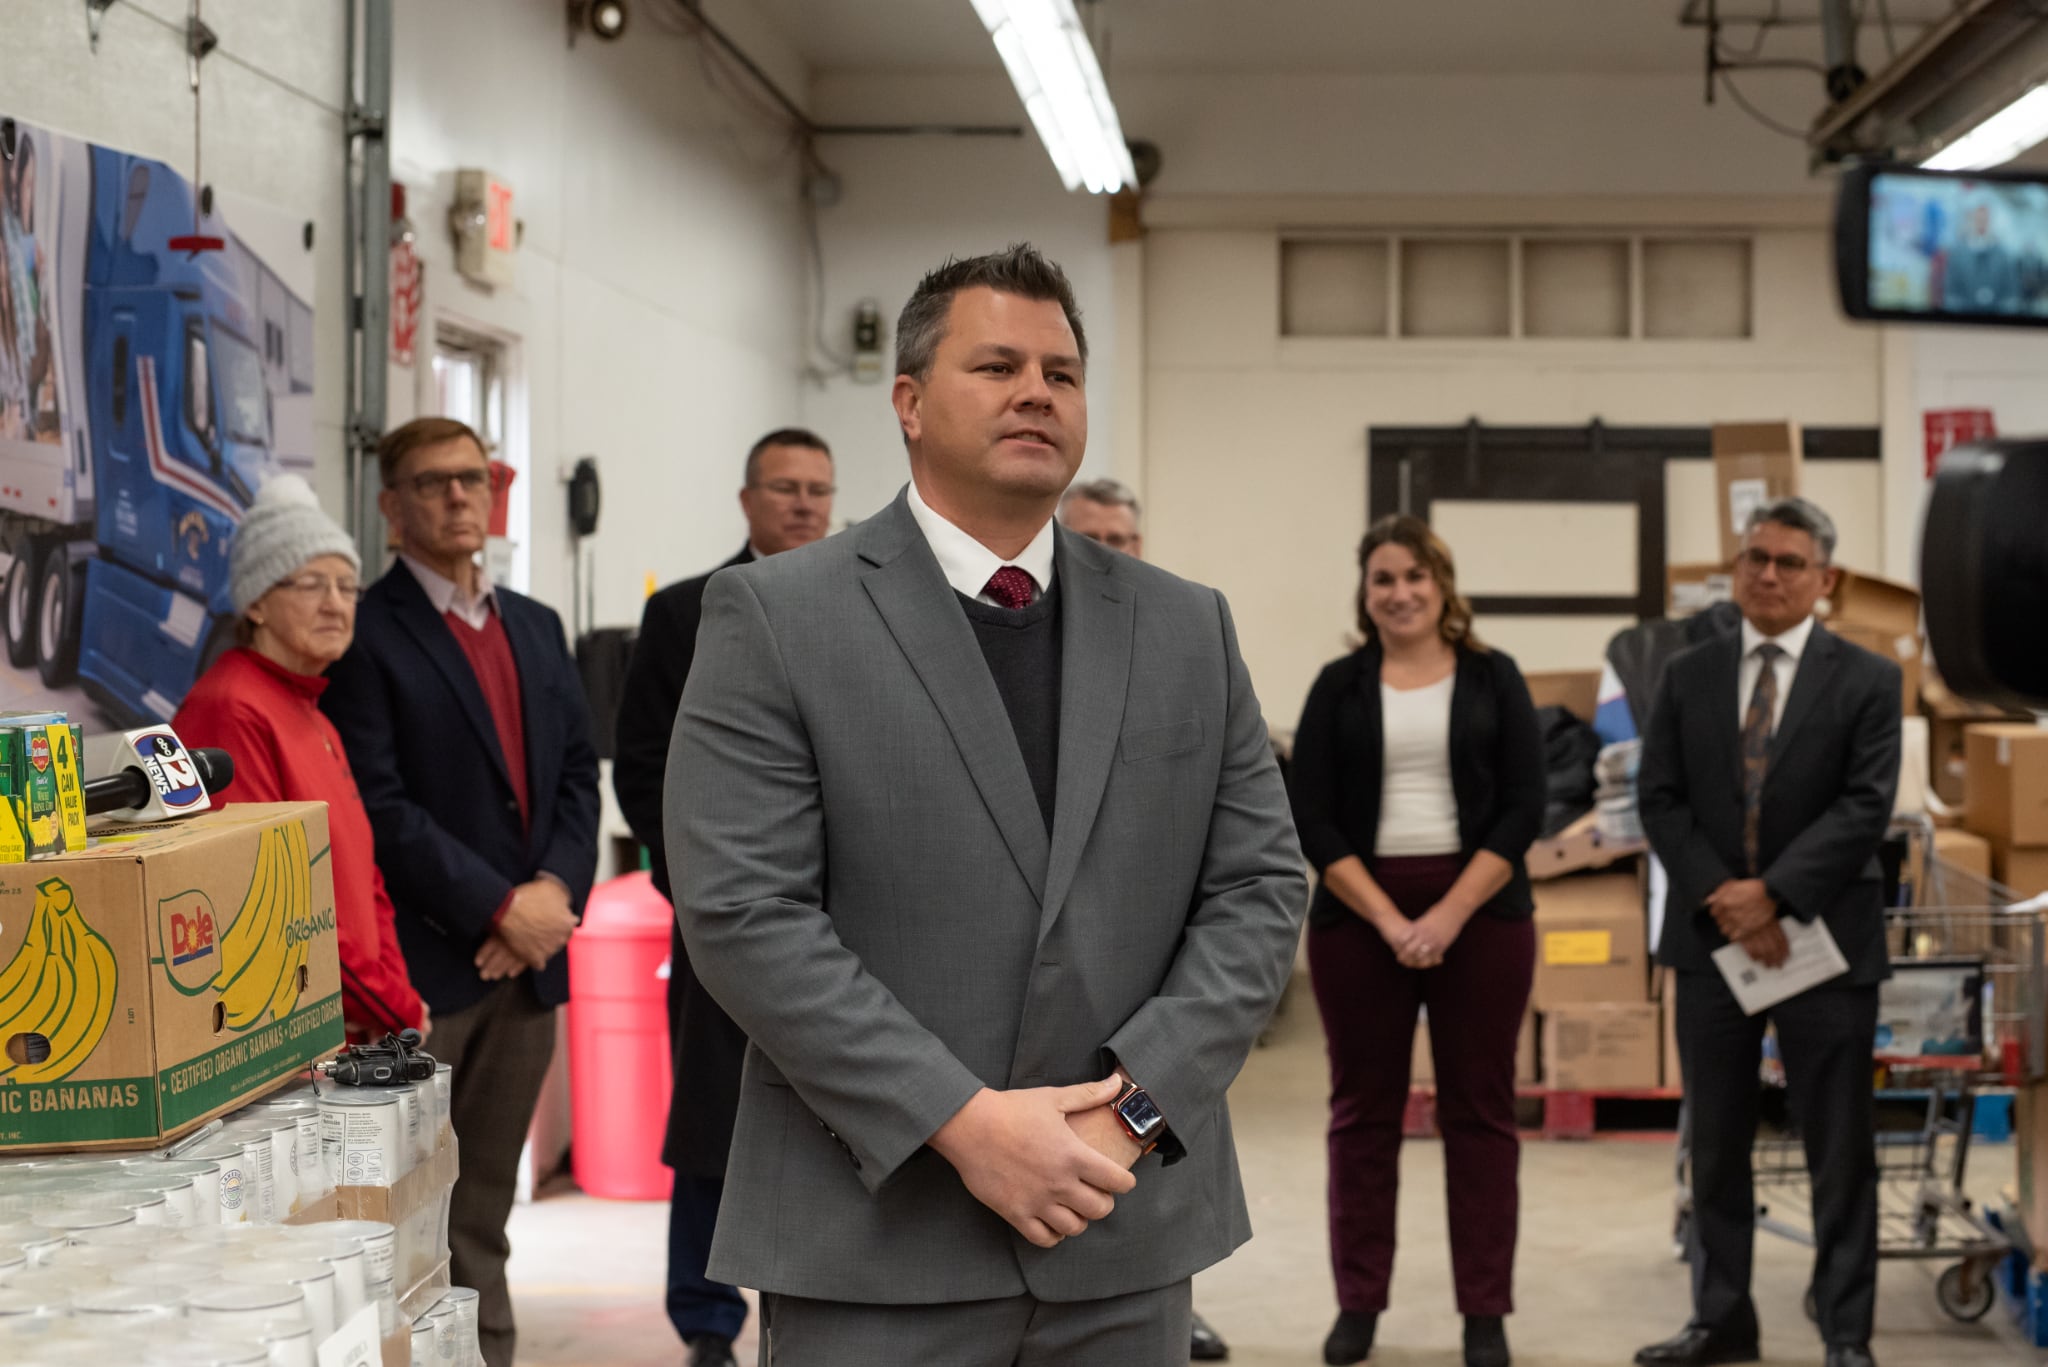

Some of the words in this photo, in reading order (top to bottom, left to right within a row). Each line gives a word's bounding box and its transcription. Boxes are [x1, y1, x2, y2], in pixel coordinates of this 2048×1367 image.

[57, 735, 68, 770] 4
[156, 737, 172, 757] abc
[61, 773, 74, 793] CAN
[143, 756, 172, 796] NEWS
[154, 748, 196, 790] 12
[65, 795, 78, 809] VALUE
[68, 811, 80, 827] PACK
[171, 905, 214, 956] Dole
[285, 907, 335, 948] ORGANIC
[170, 1059, 213, 1096] CERTIFIED
[215, 1040, 249, 1073] ORGANIC
[250, 1025, 285, 1059] BANANAS
[289, 1006, 321, 1040] CERTIFIED
[29, 1083, 139, 1113] BANANAS
